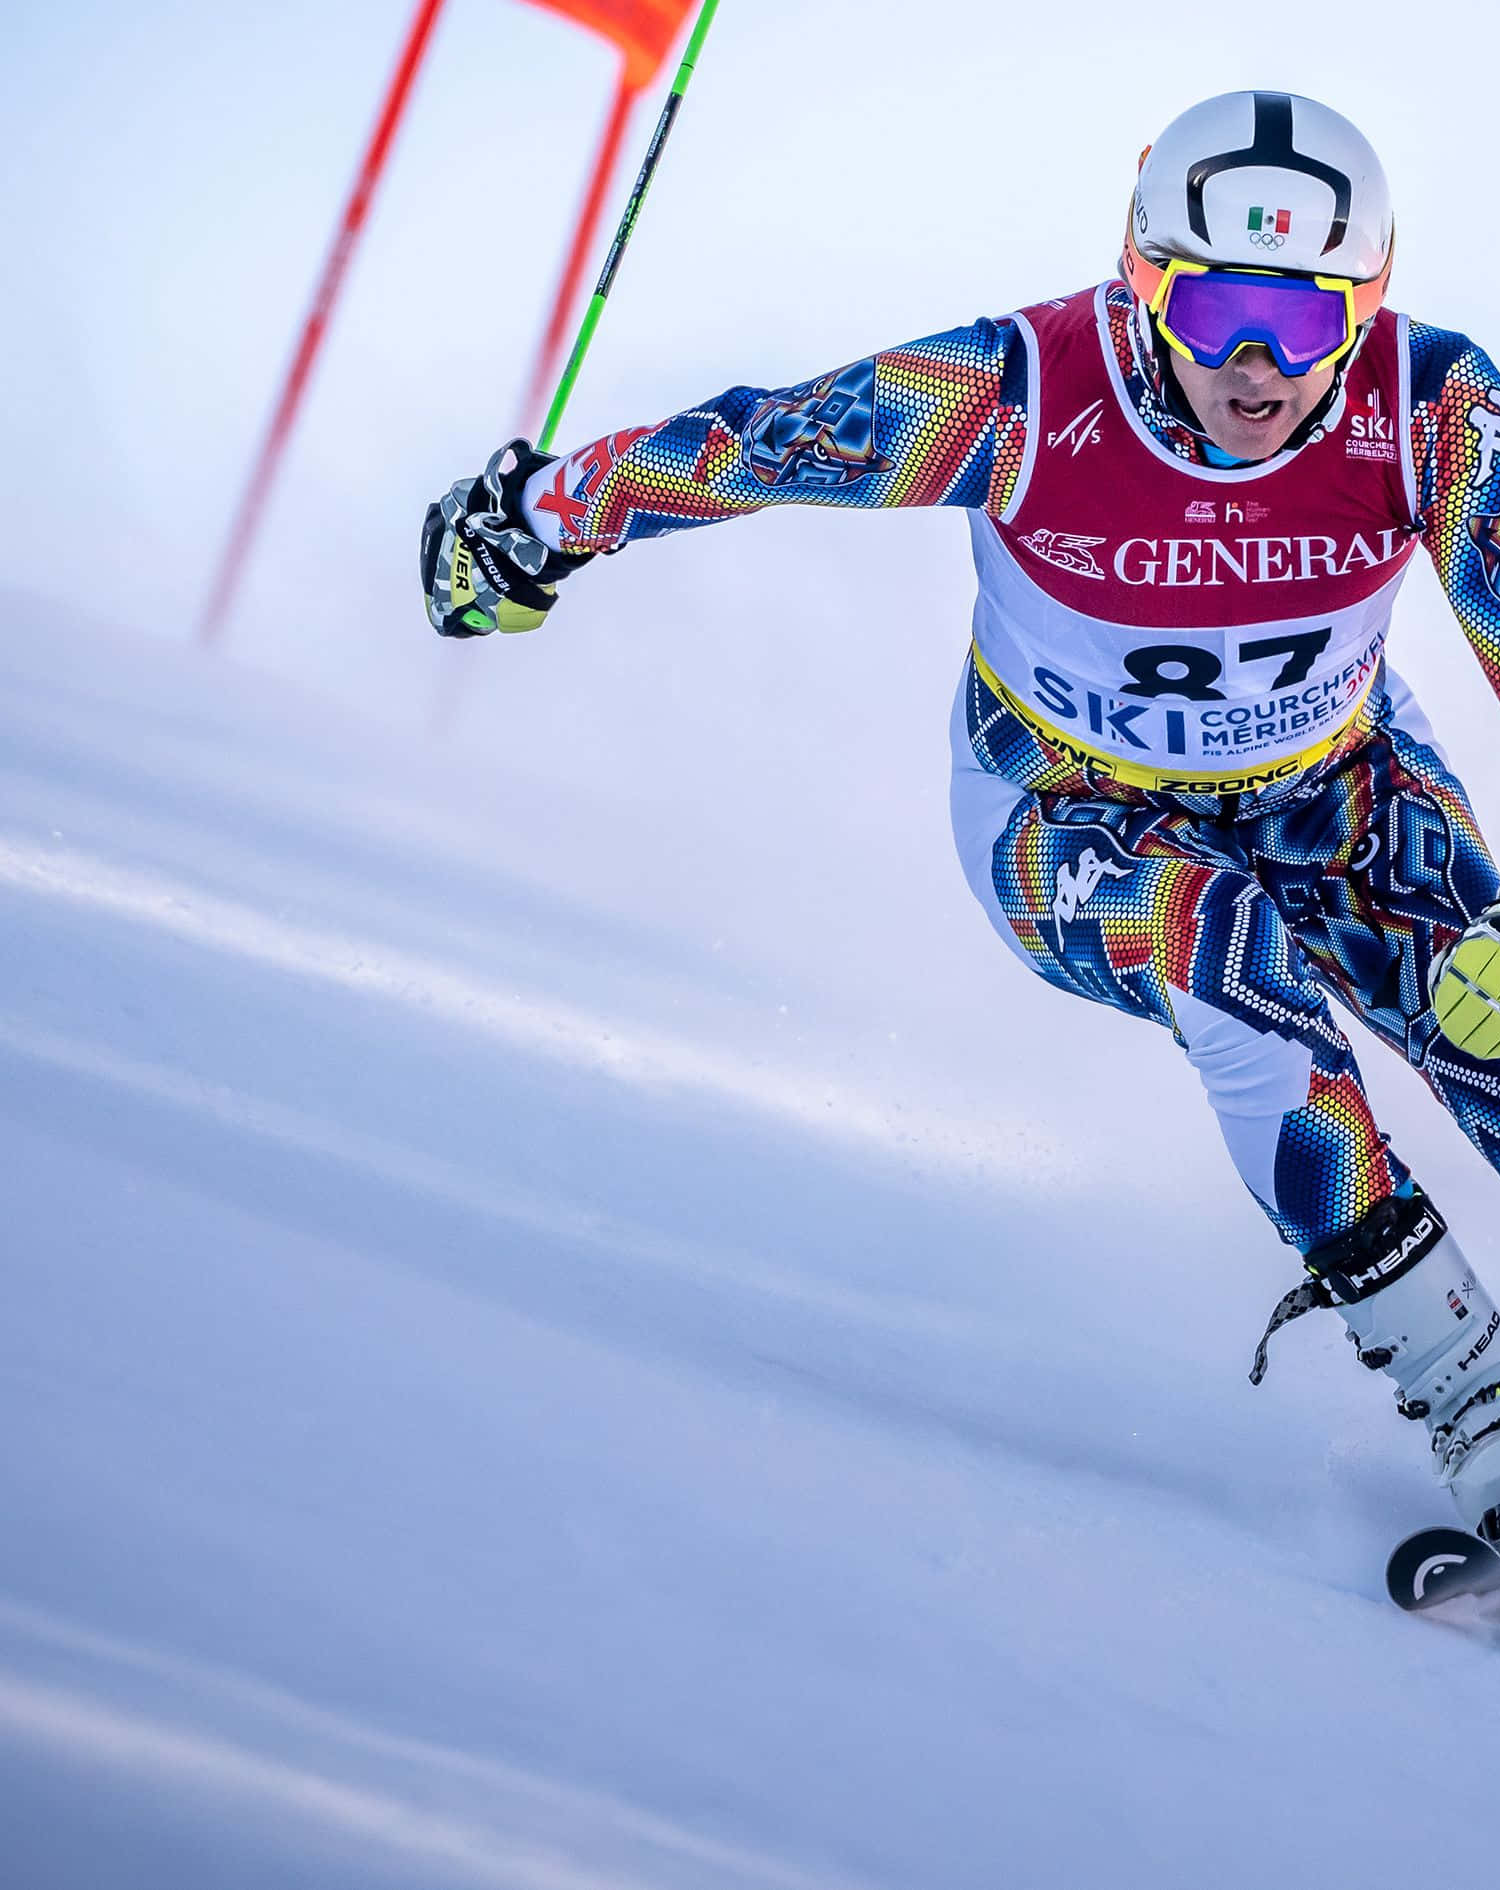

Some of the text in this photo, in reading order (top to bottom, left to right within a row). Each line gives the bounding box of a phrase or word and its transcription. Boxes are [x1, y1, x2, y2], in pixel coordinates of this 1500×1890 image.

[1351, 415, 1393, 440] SKI
[1113, 528, 1410, 586] GENERAL
[1119, 627, 1332, 701] 87
[1033, 667, 1188, 755] SKI
[1202, 696, 1344, 747] MÉRIBEL
[1226, 742, 1269, 756] ALPINE
[1273, 726, 1316, 744] WORLD
[1159, 759, 1298, 793] ZGONC
[1350, 1216, 1433, 1289] HEAD
[1457, 1311, 1500, 1371] HEAD
